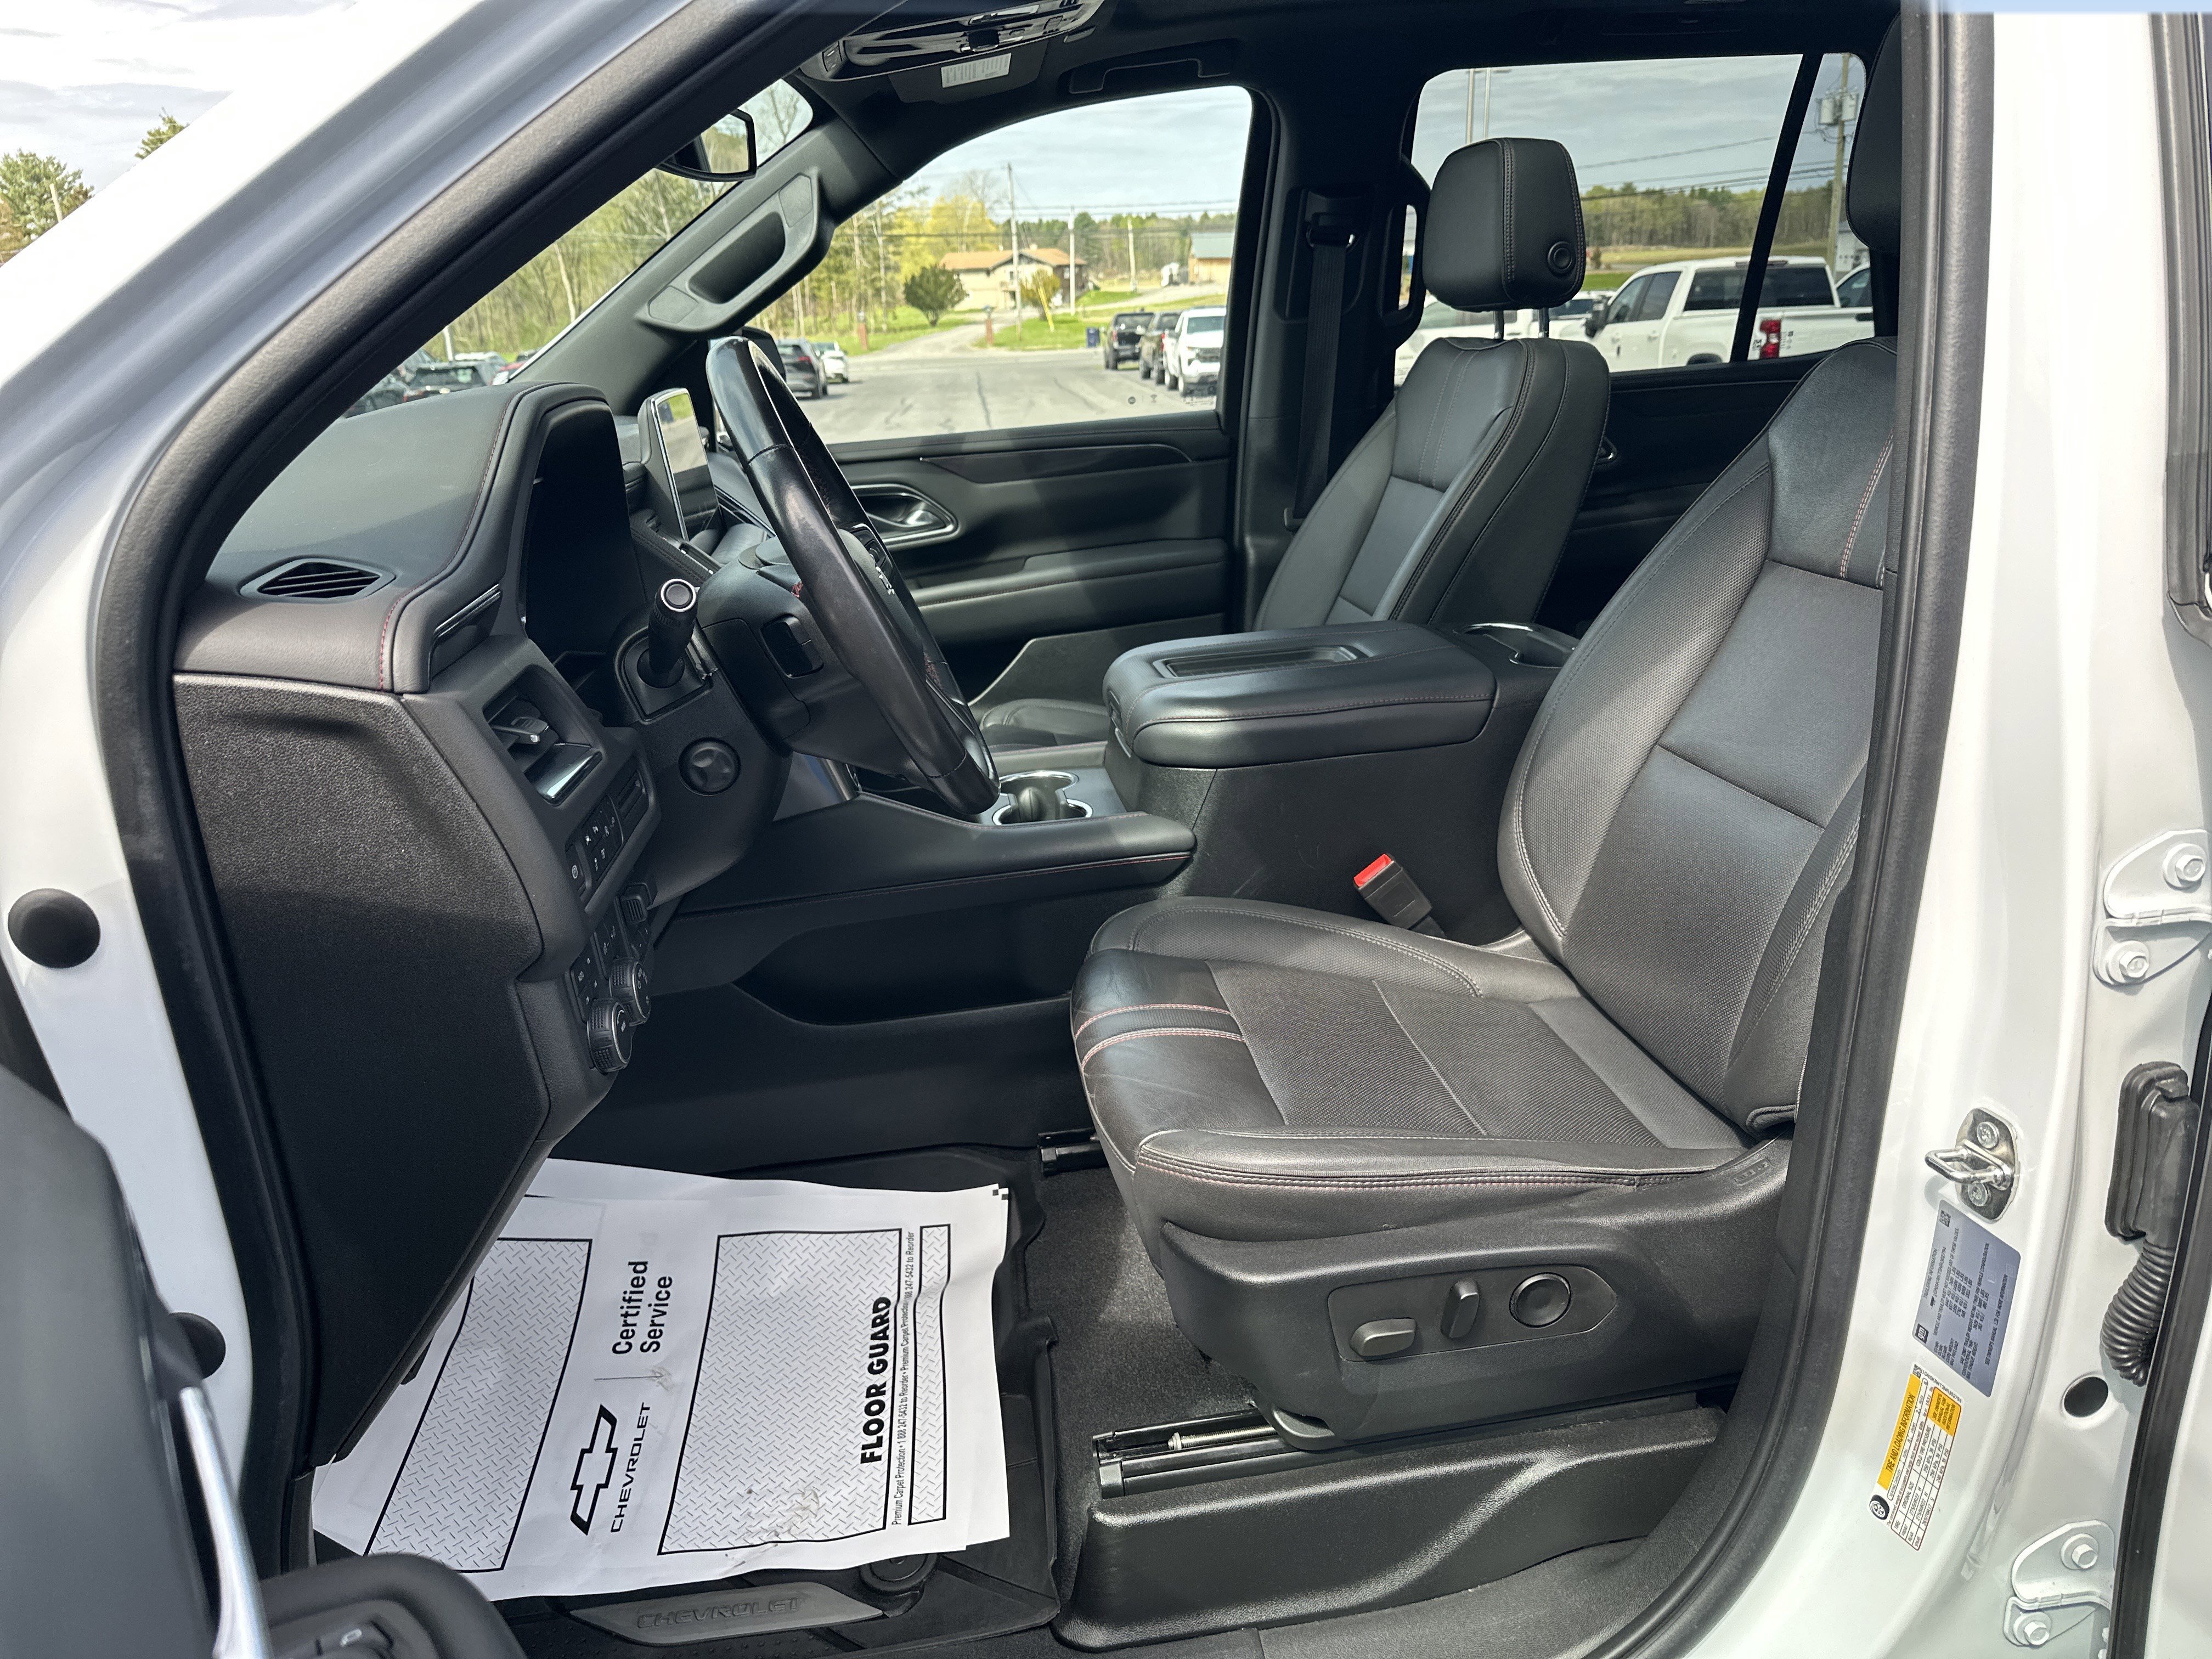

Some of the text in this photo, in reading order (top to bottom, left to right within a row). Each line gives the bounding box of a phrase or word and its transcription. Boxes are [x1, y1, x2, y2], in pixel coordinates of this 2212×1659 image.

[906, 1231, 915, 1255] Reorder
[905, 1263, 914, 1289] 247-5432
[1923, 1248, 1937, 1299] TRAILERING INFORMATION
[612, 1260, 648, 1355] Certified
[640, 1276, 673, 1353] Service
[901, 1328, 911, 1347] Carpet
[1918, 1327, 1926, 1340] gm
[900, 1347, 909, 1371] Premium
[860, 1296, 891, 1464] FLOOR GUARD
[899, 1376, 909, 1398] Reorder
[898, 1404, 907, 1427] 247-5432
[1942, 1402, 1950, 1425] ADDITIONAL
[1946, 1403, 1955, 1430] INFORMATION
[897, 1428, 906, 1440] 888
[1886, 1393, 1915, 1472] TIRE AND LOADING INFORMATION
[611, 1402, 651, 1533] CHEVROLET
[895, 1452, 905, 1482] Protection
[1902, 1491, 1911, 1509] ORIGINAL
[1922, 1426, 1931, 1447] PRESSURE
[894, 1477, 906, 1498] Carpet
[891, 1496, 902, 1525] Premium
[636, 1597, 803, 1628] CHEVROLET
